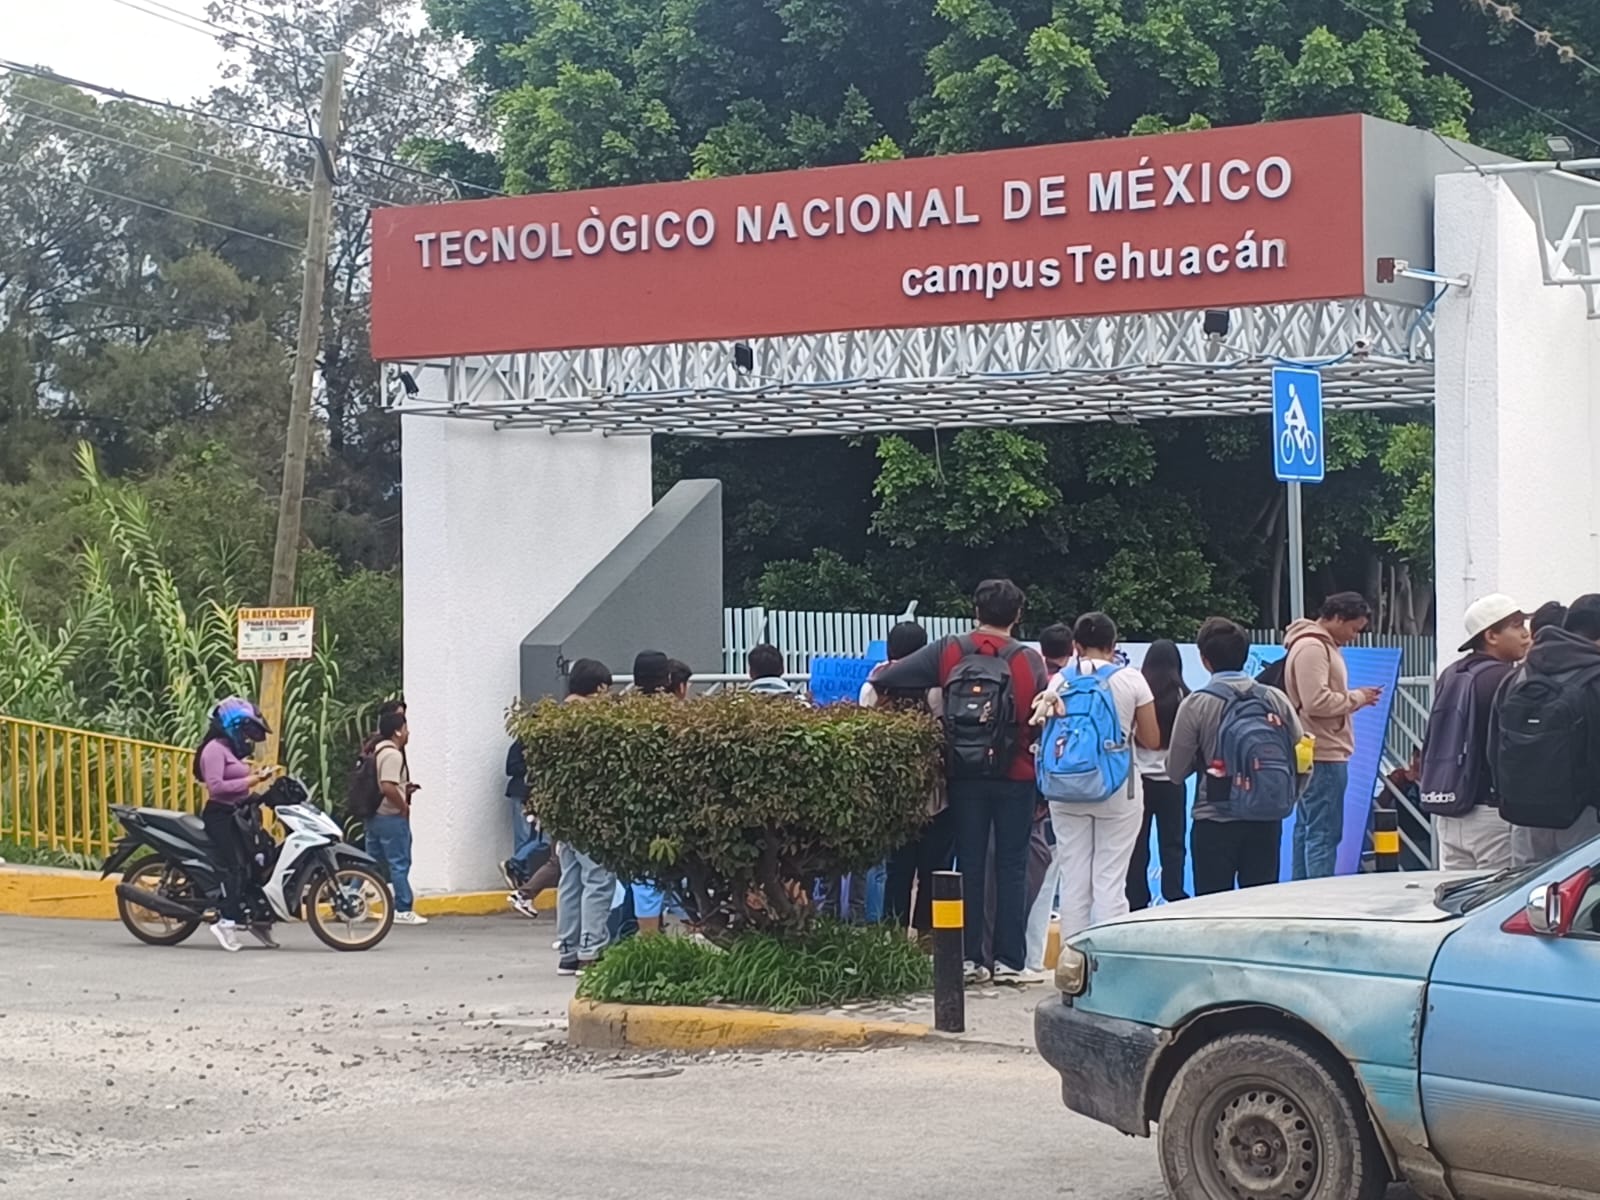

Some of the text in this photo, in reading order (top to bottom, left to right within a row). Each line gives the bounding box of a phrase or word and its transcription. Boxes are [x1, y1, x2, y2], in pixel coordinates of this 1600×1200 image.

[414, 156, 1292, 268] TECNOLÒGICO NACIONAL DE MÉXICO
[902, 229, 1286, 299] campus Tehuacán
[1420, 791, 1456, 803] adidas
